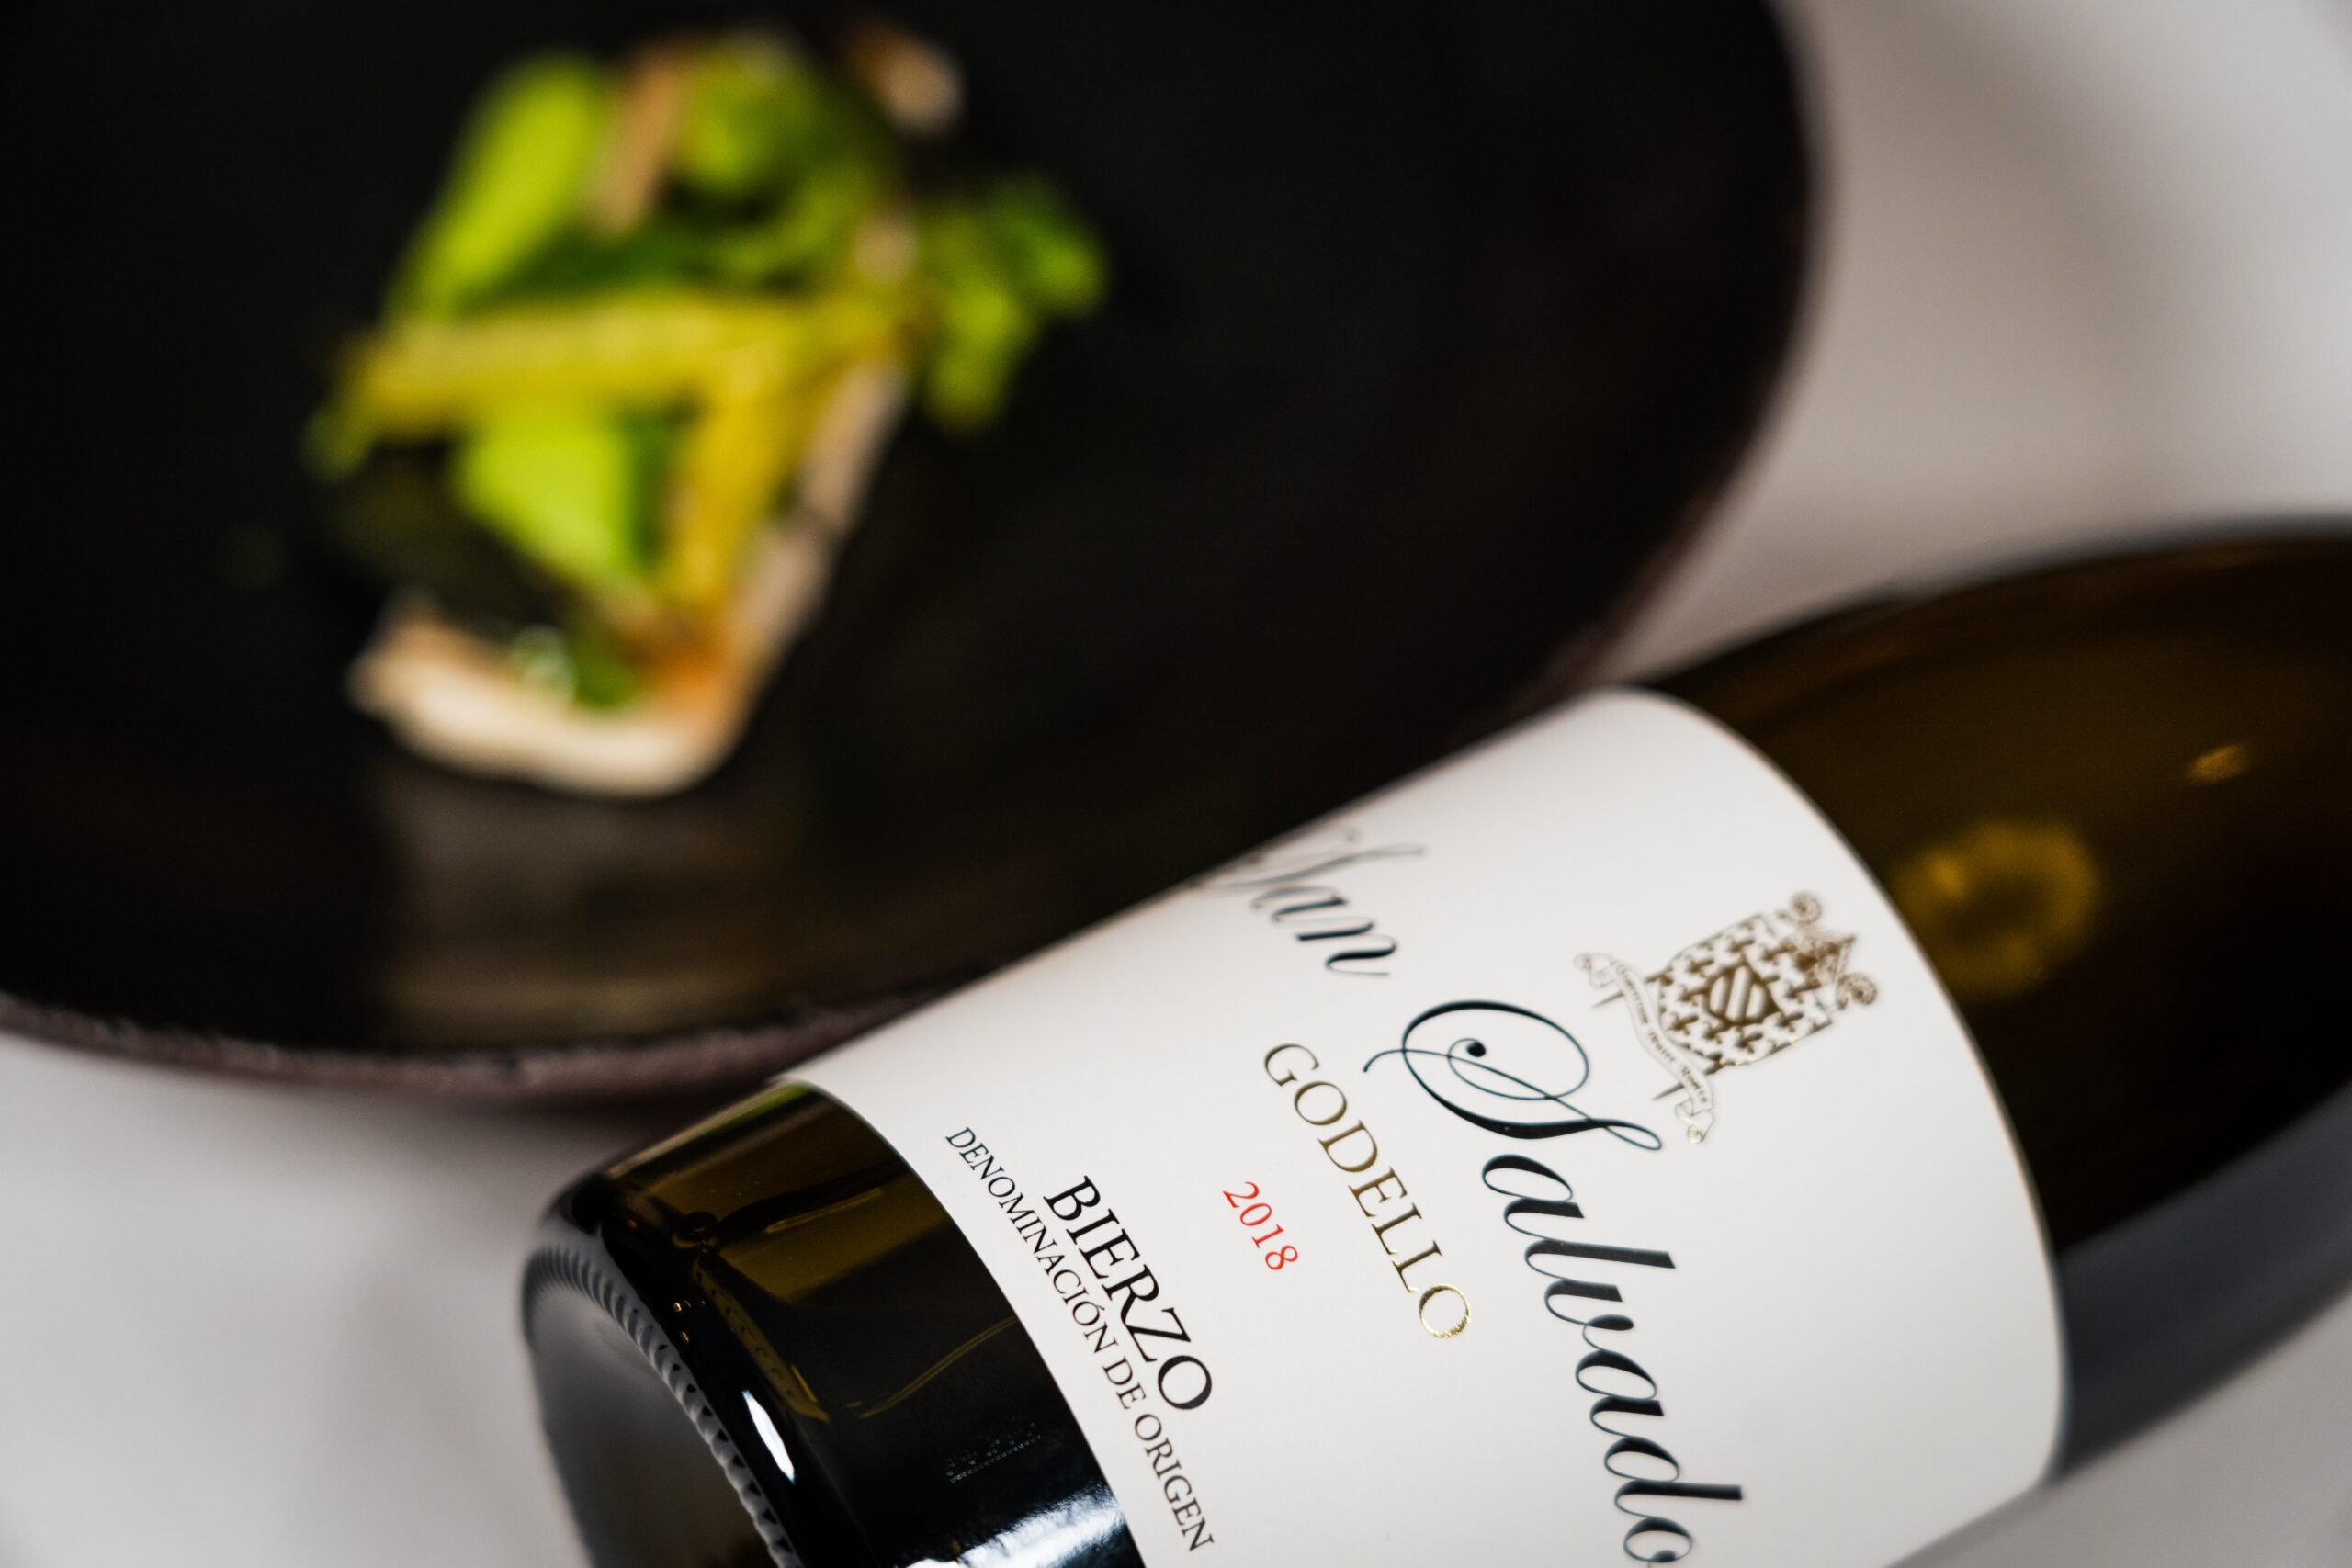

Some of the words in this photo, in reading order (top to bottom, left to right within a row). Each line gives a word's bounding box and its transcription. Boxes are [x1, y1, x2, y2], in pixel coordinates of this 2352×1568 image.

[944, 1126, 1118, 1354] DENOMINACIÓN
[1102, 1356, 1148, 1411] DE
[1134, 1413, 1216, 1552] ORIGEN
[1043, 1175, 1214, 1411] BIERZO
[1222, 1180, 1299, 1271] 2018
[1263, 1043, 1472, 1339] GODELLO
[1363, 999, 1745, 1568] Salvado
